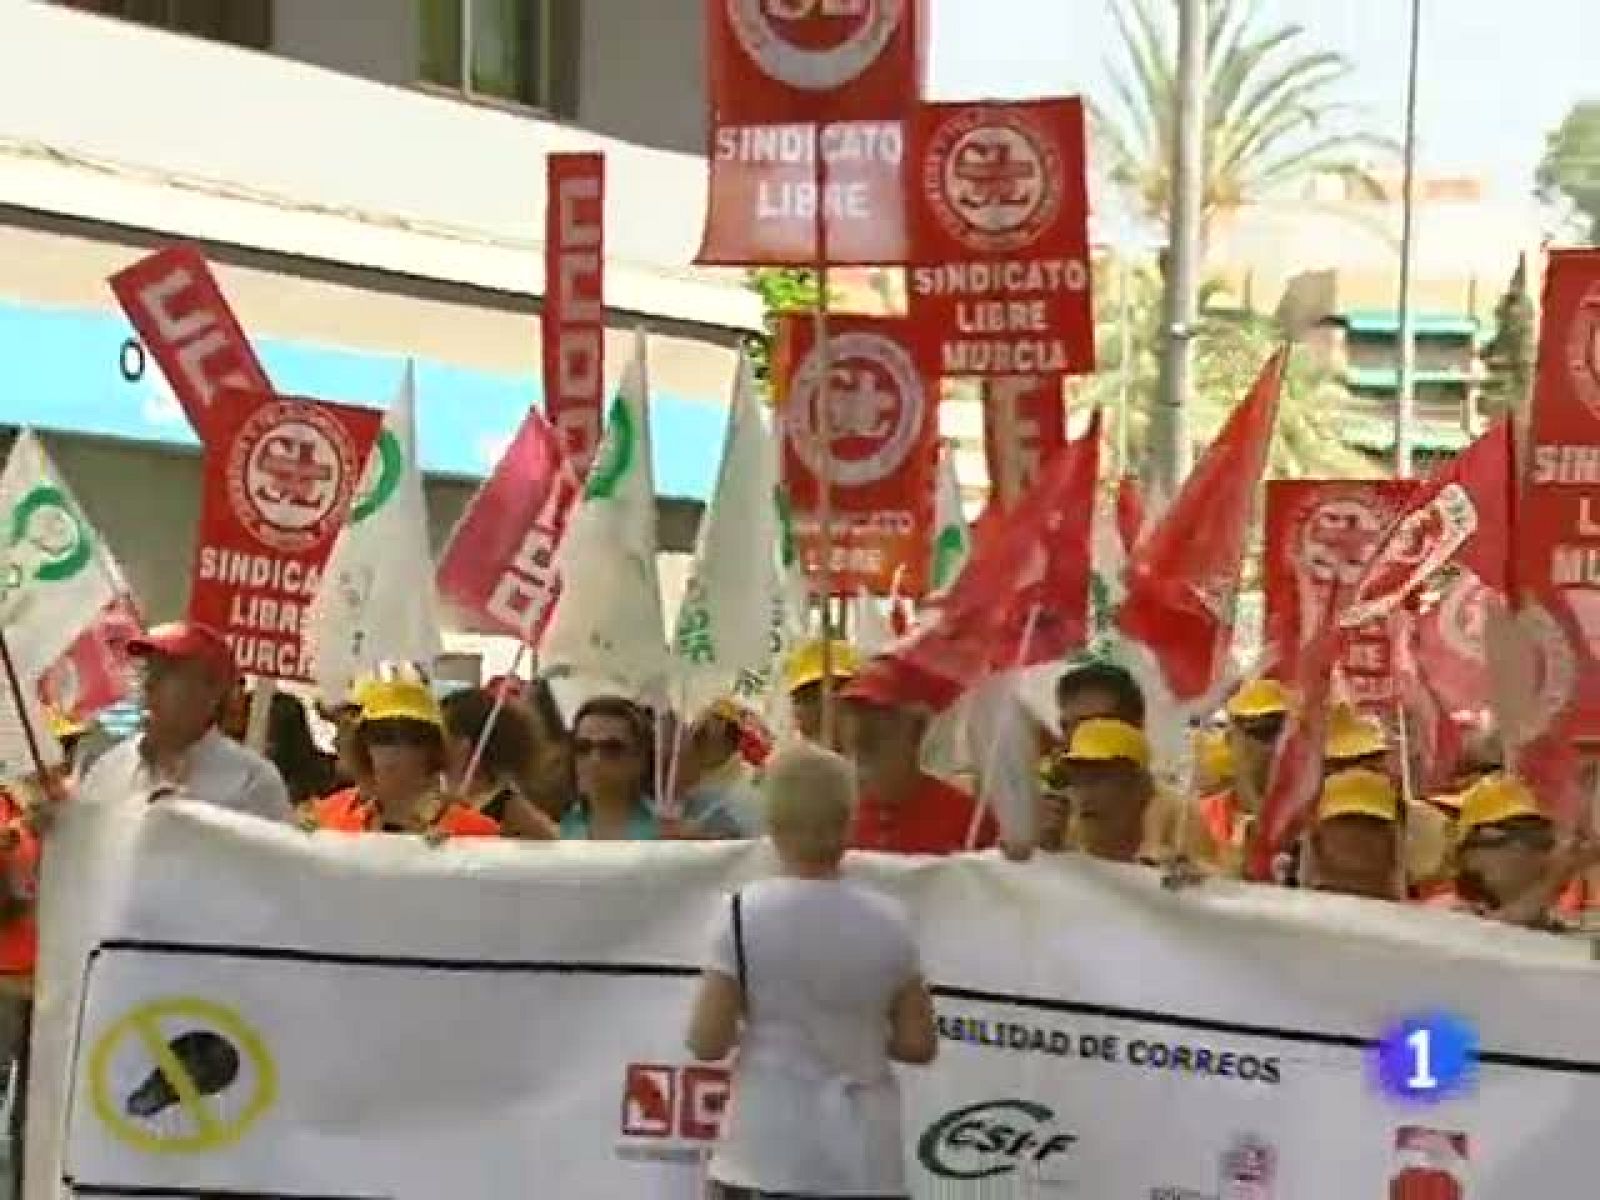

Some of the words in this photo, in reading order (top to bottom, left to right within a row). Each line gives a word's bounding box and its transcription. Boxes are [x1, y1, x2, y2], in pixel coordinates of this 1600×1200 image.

[716, 122, 903, 163] SINDICATO
[913, 260, 1088, 296] SINDICATO
[955, 301, 1049, 333] LIBRE
[941, 338, 1068, 372] MURCIA
[1079, 1034, 1120, 1062] DE
[1127, 1040, 1281, 1084] CORREOS
